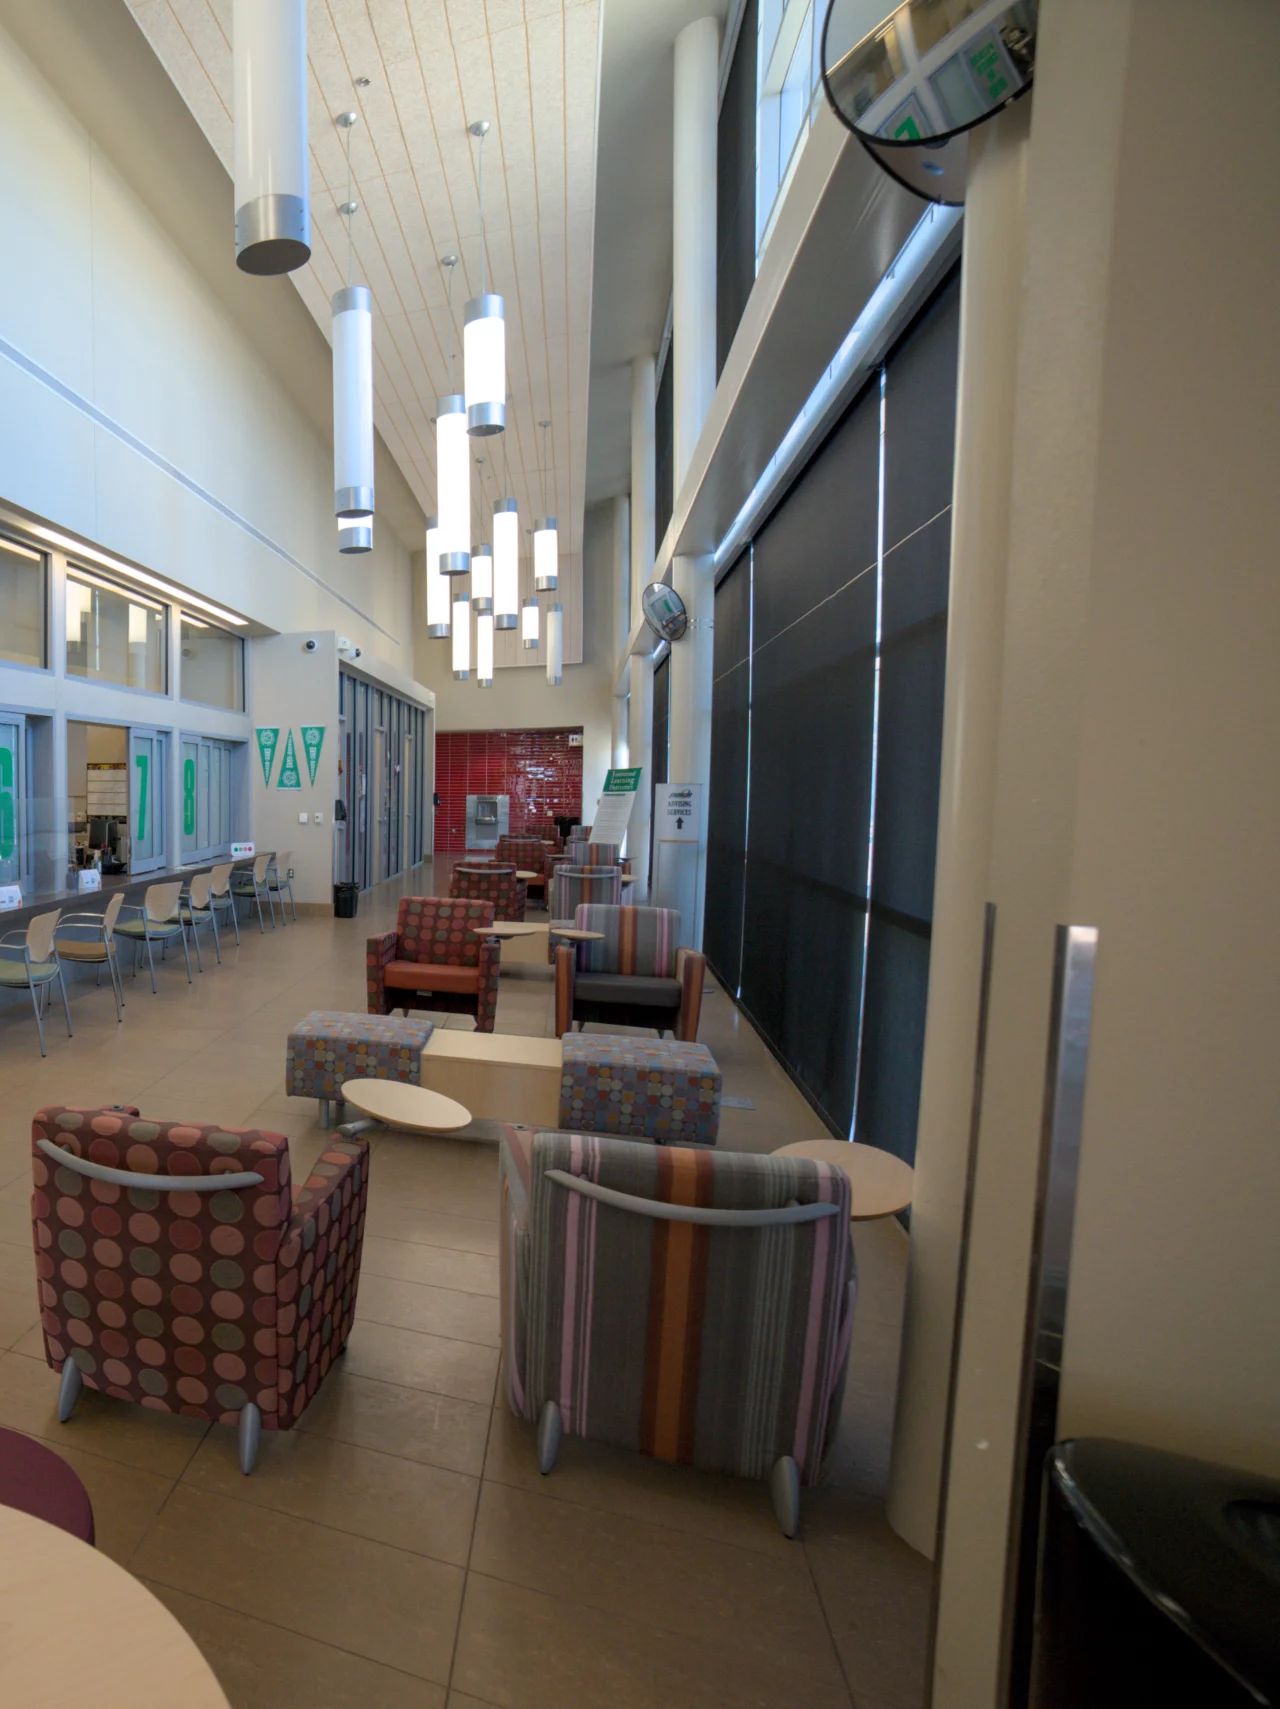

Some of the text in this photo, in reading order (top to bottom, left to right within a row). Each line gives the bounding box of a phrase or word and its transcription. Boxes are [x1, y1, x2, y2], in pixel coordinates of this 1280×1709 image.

[135, 755, 149, 841] 7
[183, 759, 195, 836] 8
[666, 808, 692, 816] SERVICES
[667, 800, 693, 808] ADVISING
